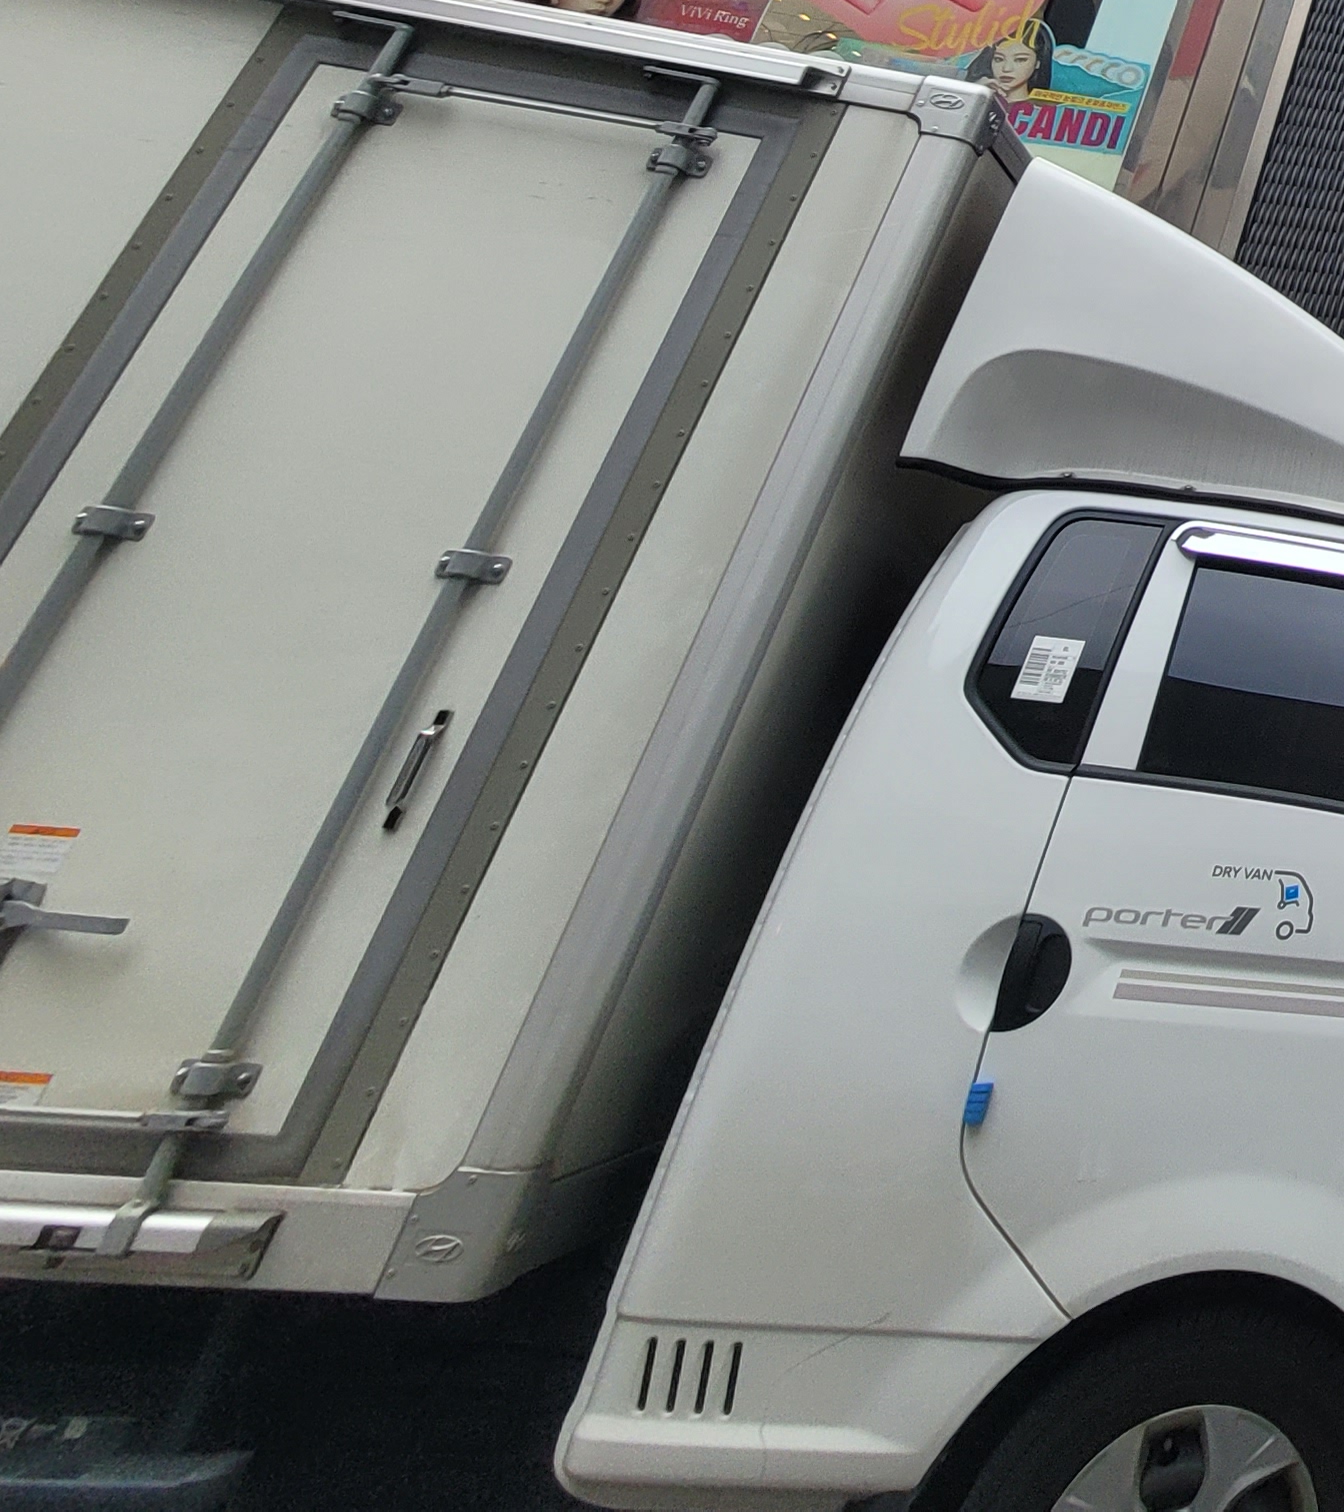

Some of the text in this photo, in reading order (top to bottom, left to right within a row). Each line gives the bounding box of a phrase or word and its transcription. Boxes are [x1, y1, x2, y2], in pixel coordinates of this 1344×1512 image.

[680, 4, 750, 28] ViVi Ring
[1212, 865, 1274, 881] DRY VAN
[1082, 906, 1226, 931] porter
